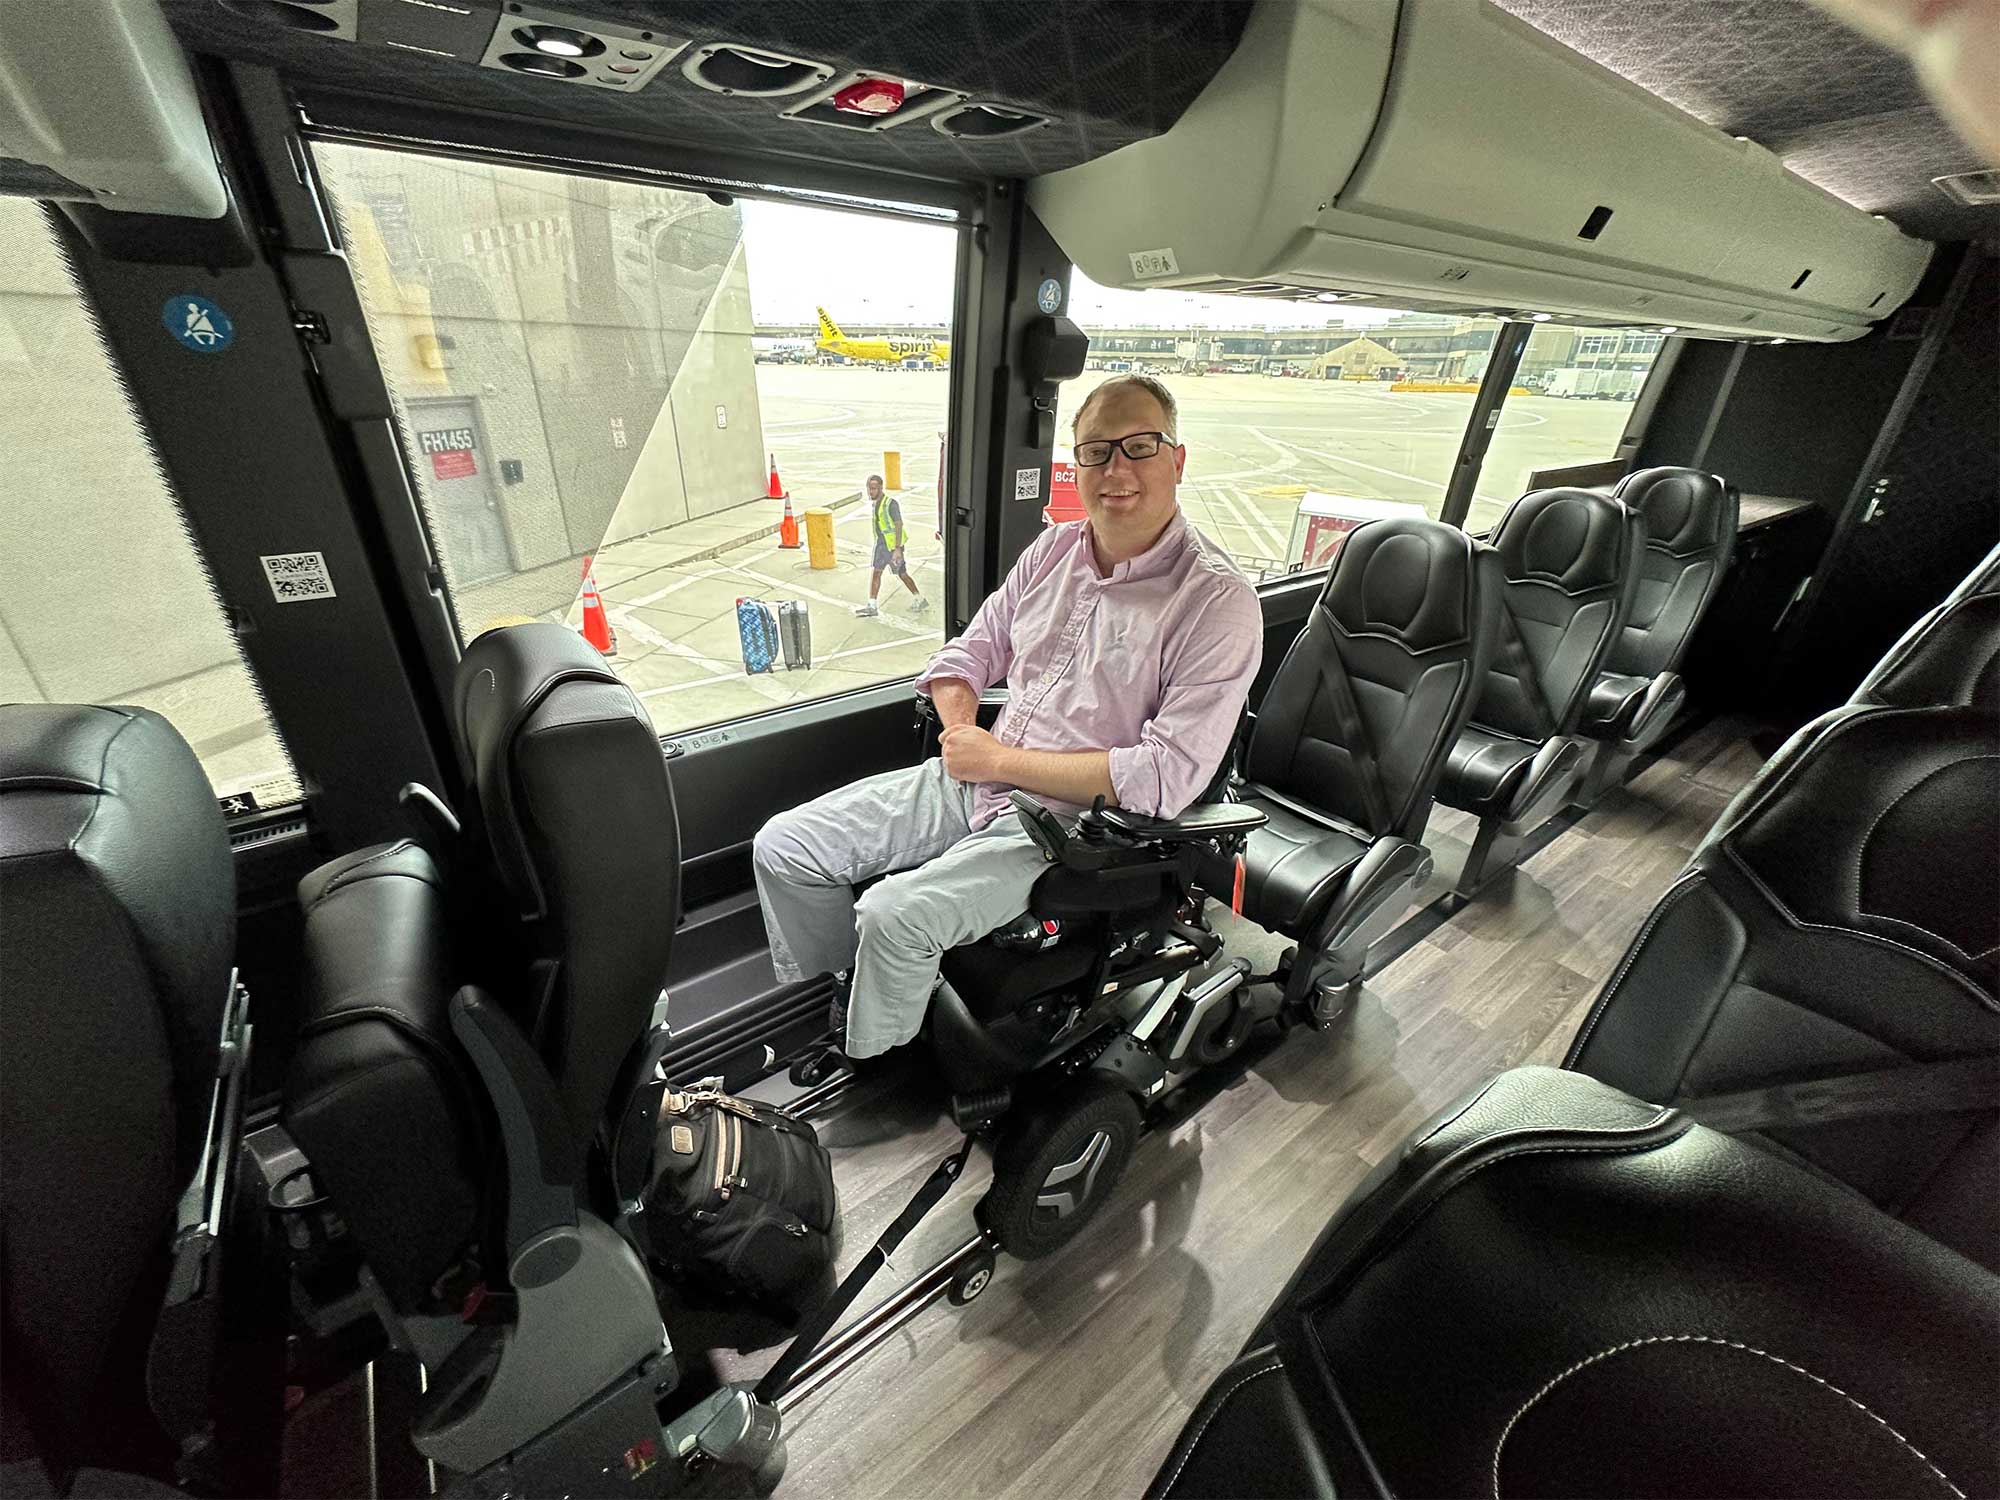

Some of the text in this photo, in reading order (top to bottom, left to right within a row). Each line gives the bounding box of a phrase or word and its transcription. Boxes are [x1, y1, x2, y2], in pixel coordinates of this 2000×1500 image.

[817, 307, 838, 337] spirit
[889, 341, 932, 356] spirit
[421, 429, 473, 453] FH1455
